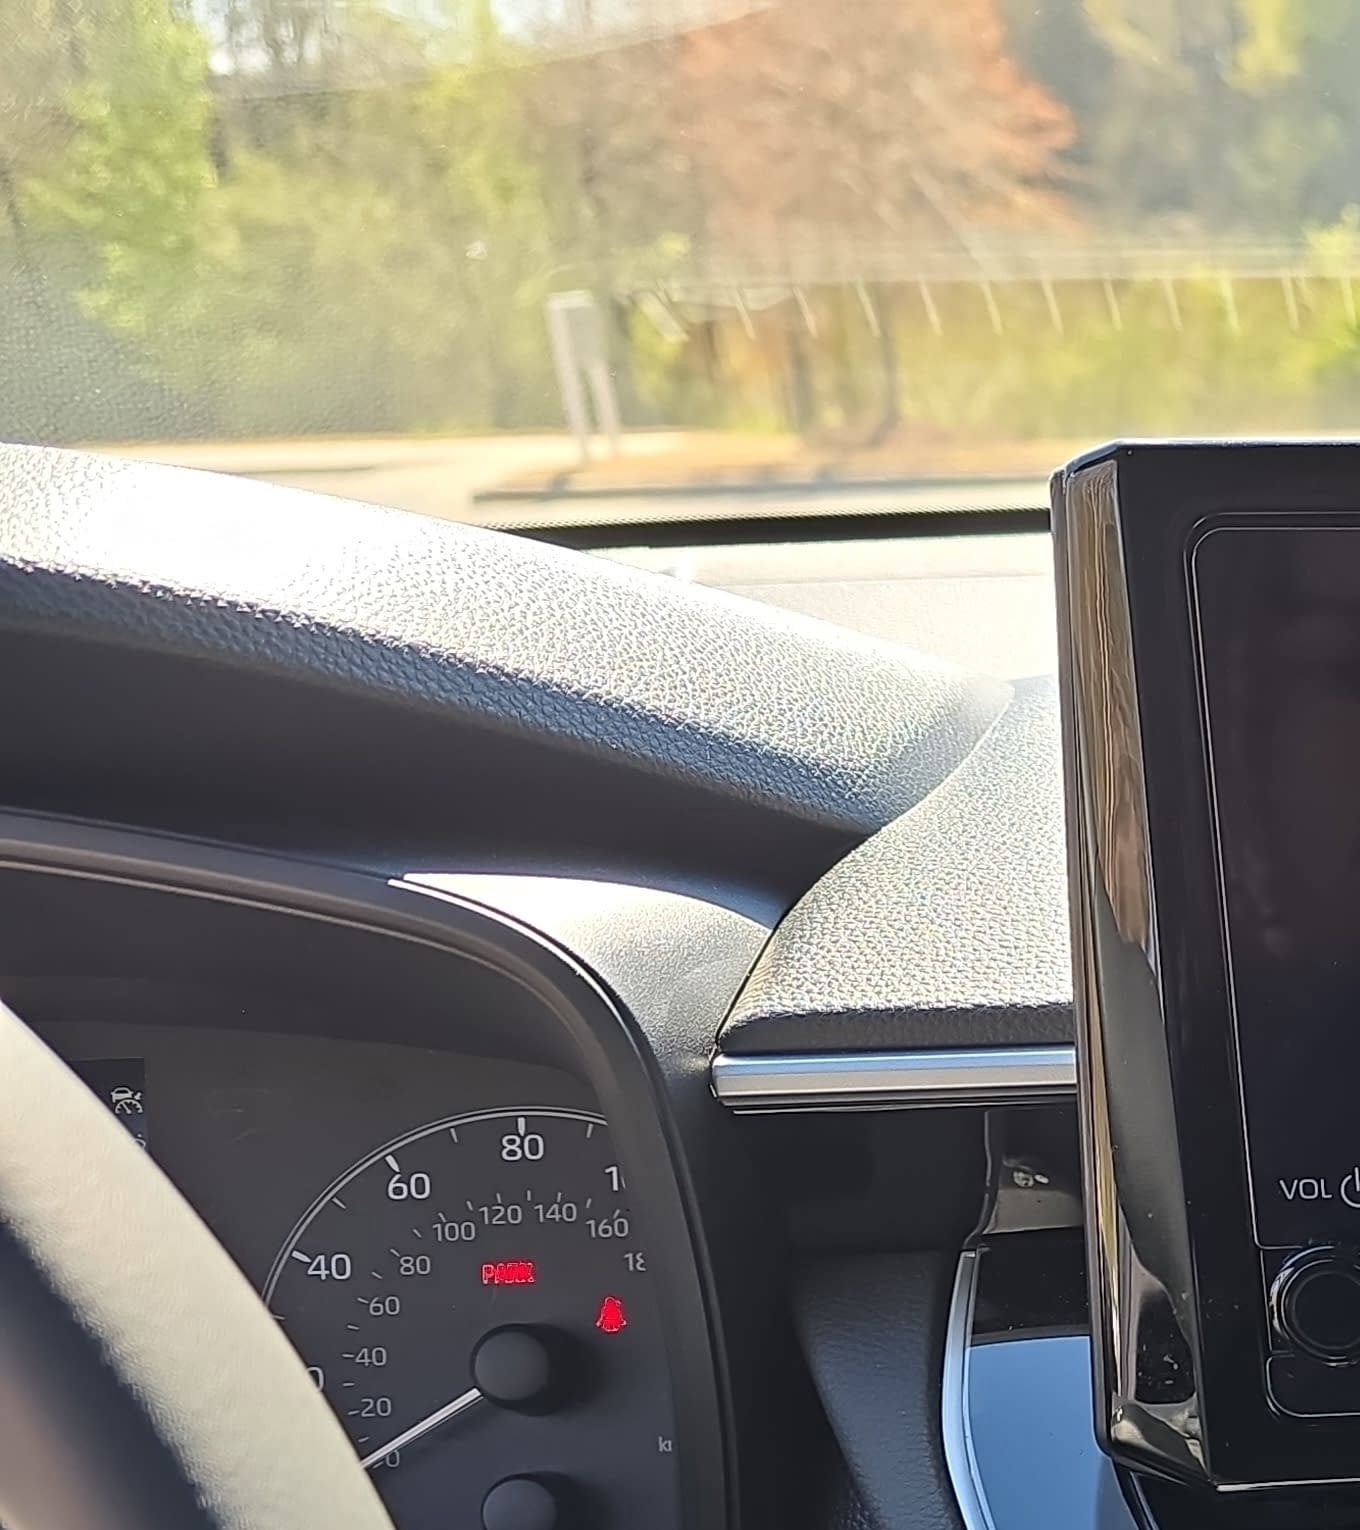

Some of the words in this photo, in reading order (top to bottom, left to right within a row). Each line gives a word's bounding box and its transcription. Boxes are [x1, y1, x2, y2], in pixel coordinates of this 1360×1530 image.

[501, 1133, 545, 1162] 80
[387, 1173, 431, 1200] 60
[1279, 1178, 1333, 1201] VOL
[478, 1205, 523, 1226] 120
[534, 1203, 578, 1223] 140
[432, 1222, 476, 1242] 100
[586, 1218, 629, 1239] 160
[307, 1254, 352, 1280] 40
[399, 1255, 431, 1276] 80
[368, 1296, 400, 1316] 60
[354, 1347, 388, 1367] 40
[359, 1397, 392, 1417] 20
